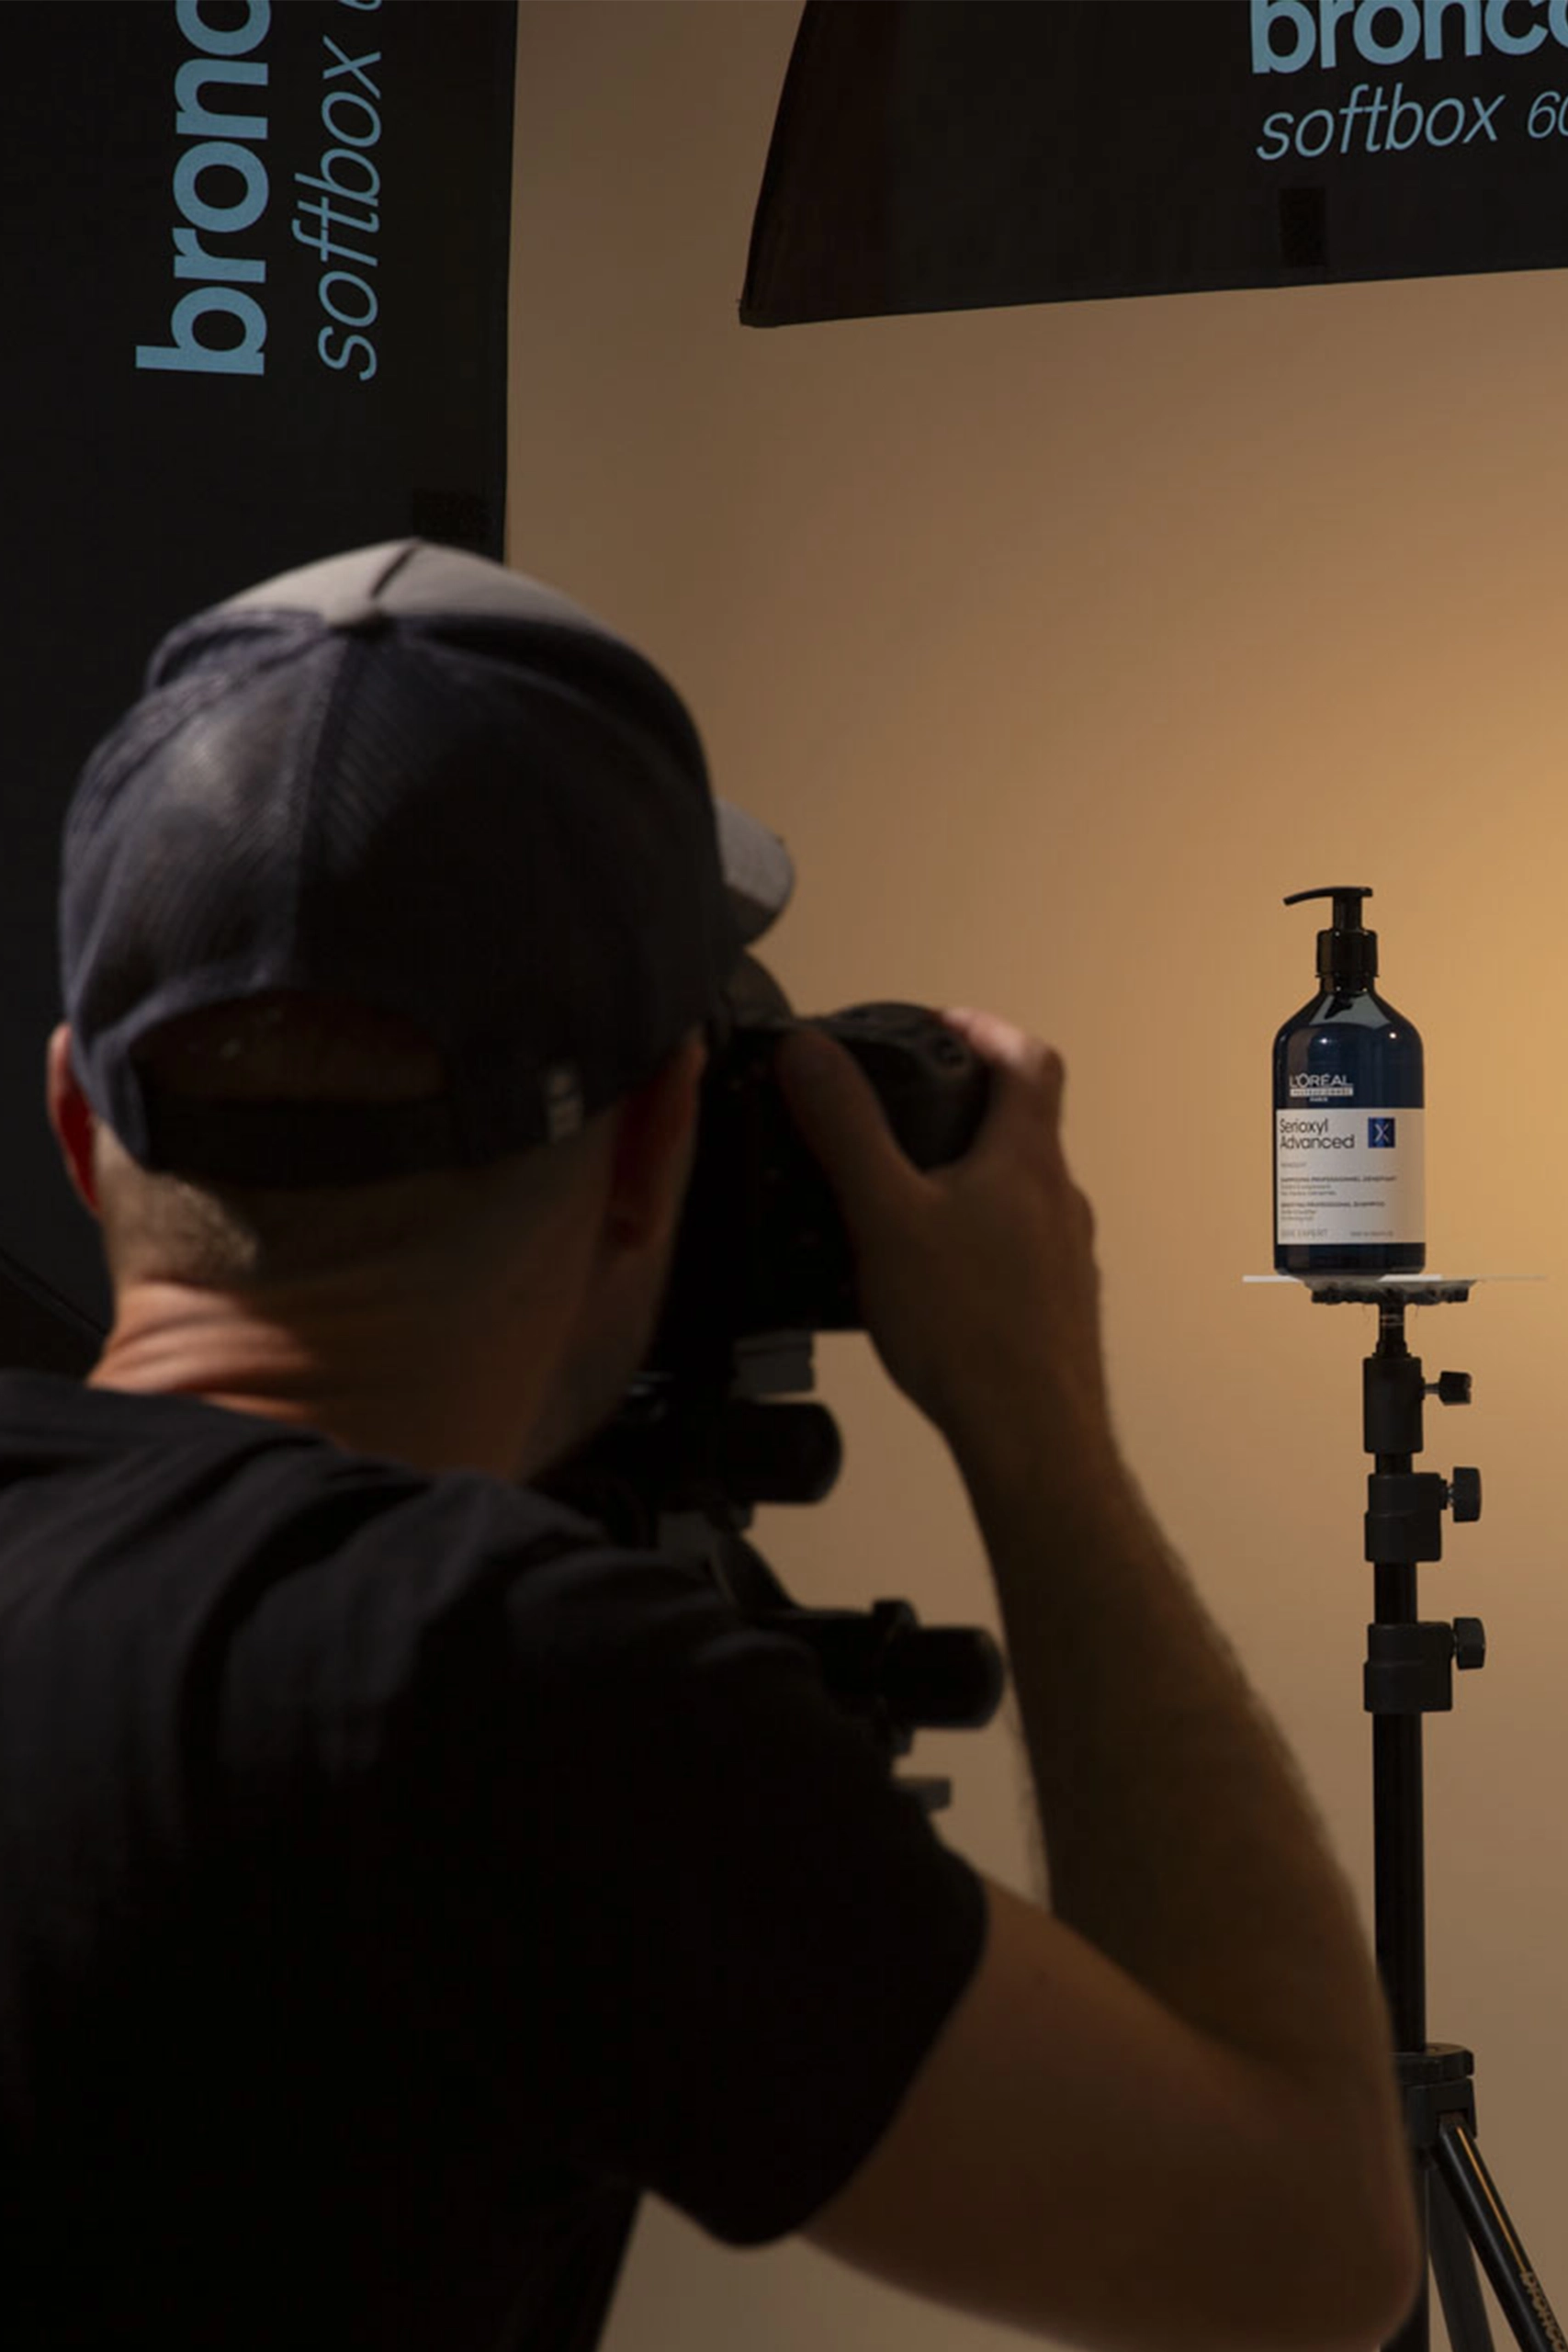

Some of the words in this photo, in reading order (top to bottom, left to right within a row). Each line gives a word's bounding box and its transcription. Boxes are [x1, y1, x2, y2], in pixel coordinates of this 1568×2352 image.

[1250, 0, 1568, 74] bronc
[1256, 83, 1506, 161] softbox
[291, 35, 382, 381] softbox
[1280, 1117, 1328, 1136] Serioxyl
[1280, 1134, 1355, 1149] Advanced
